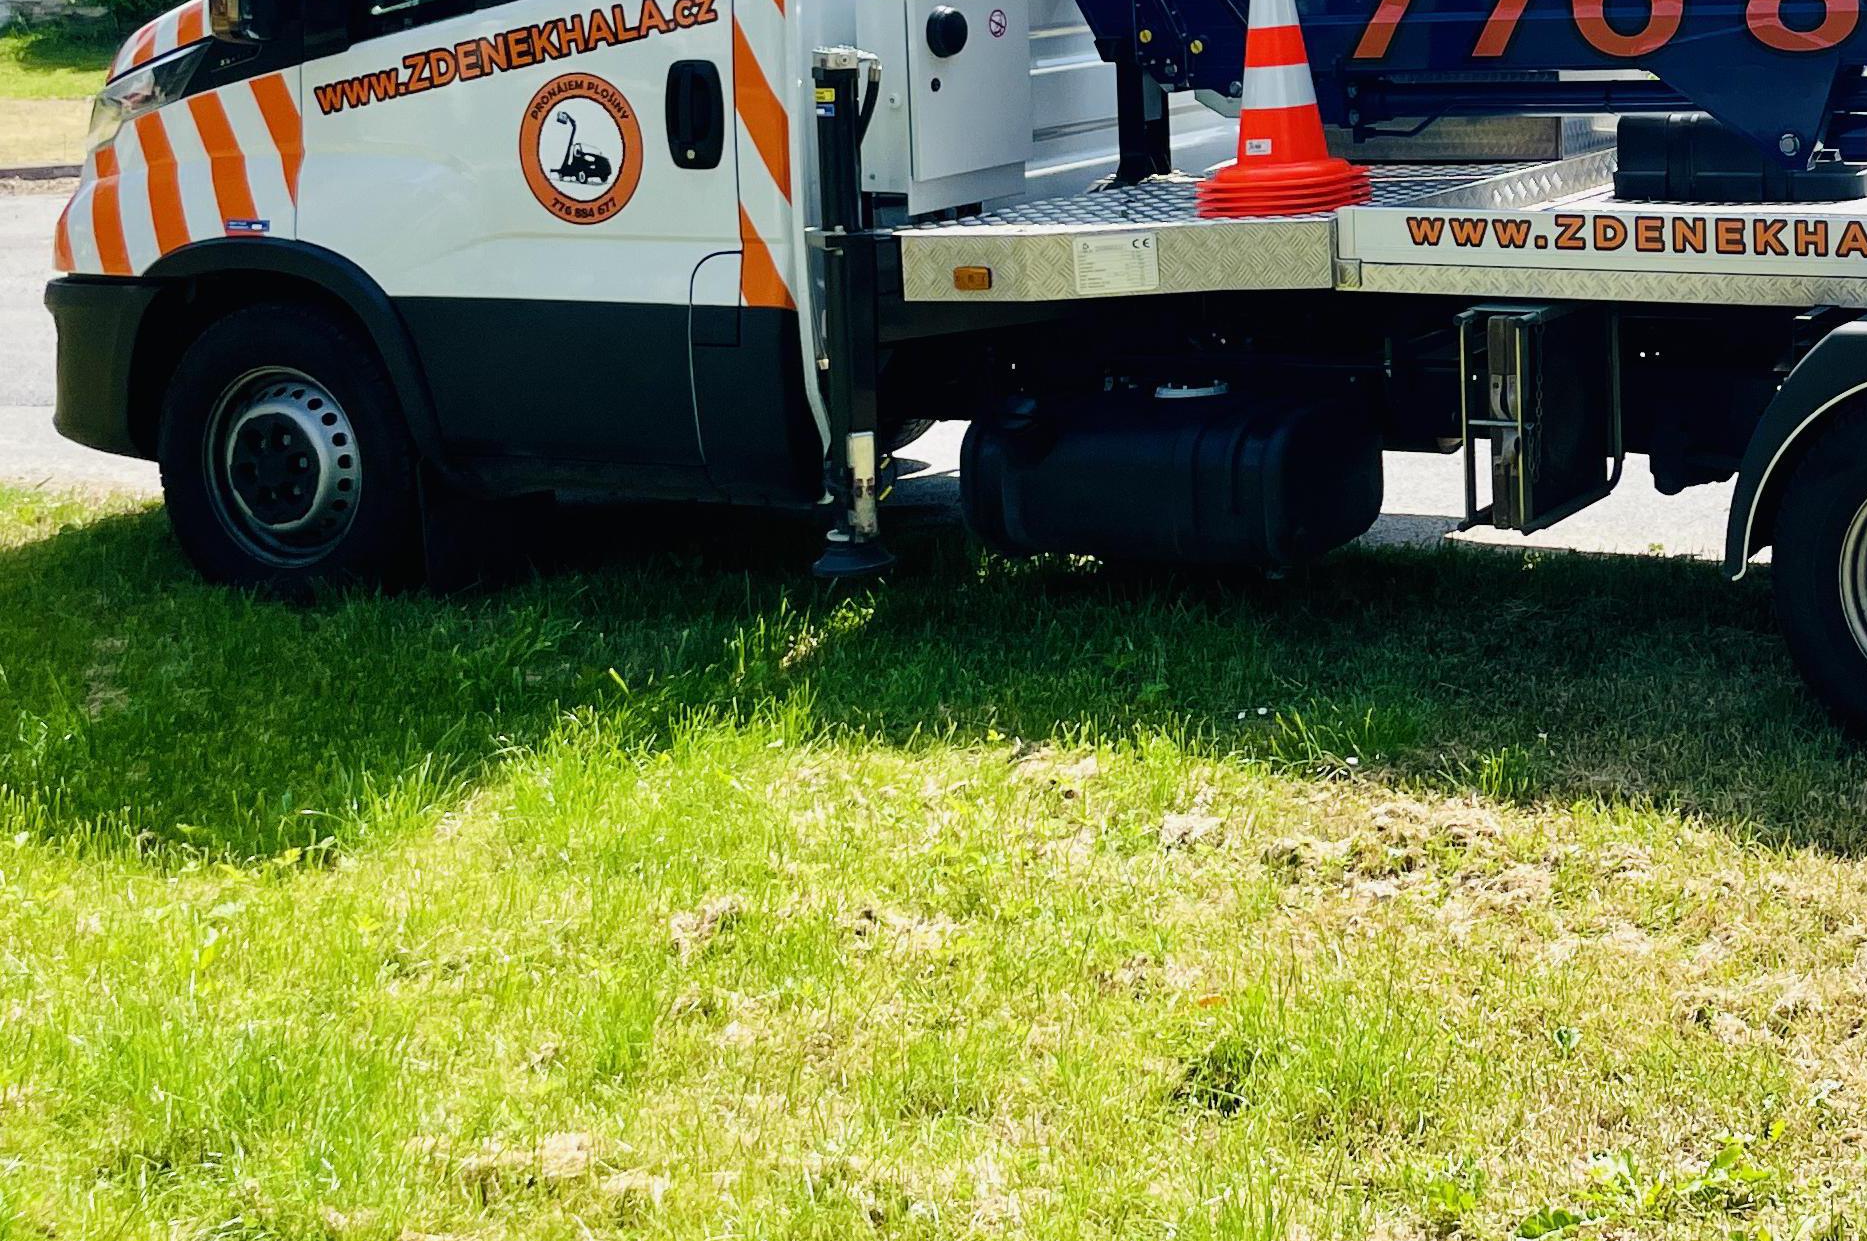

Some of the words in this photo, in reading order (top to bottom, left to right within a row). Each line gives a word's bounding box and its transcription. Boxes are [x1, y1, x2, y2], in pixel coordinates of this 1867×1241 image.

[531, 80, 584, 120] PRONÁJEM
[587, 81, 629, 120] PLOŠINY
[552, 197, 573, 215] 776
[575, 206, 595, 218] 884
[599, 197, 617, 214] 677
